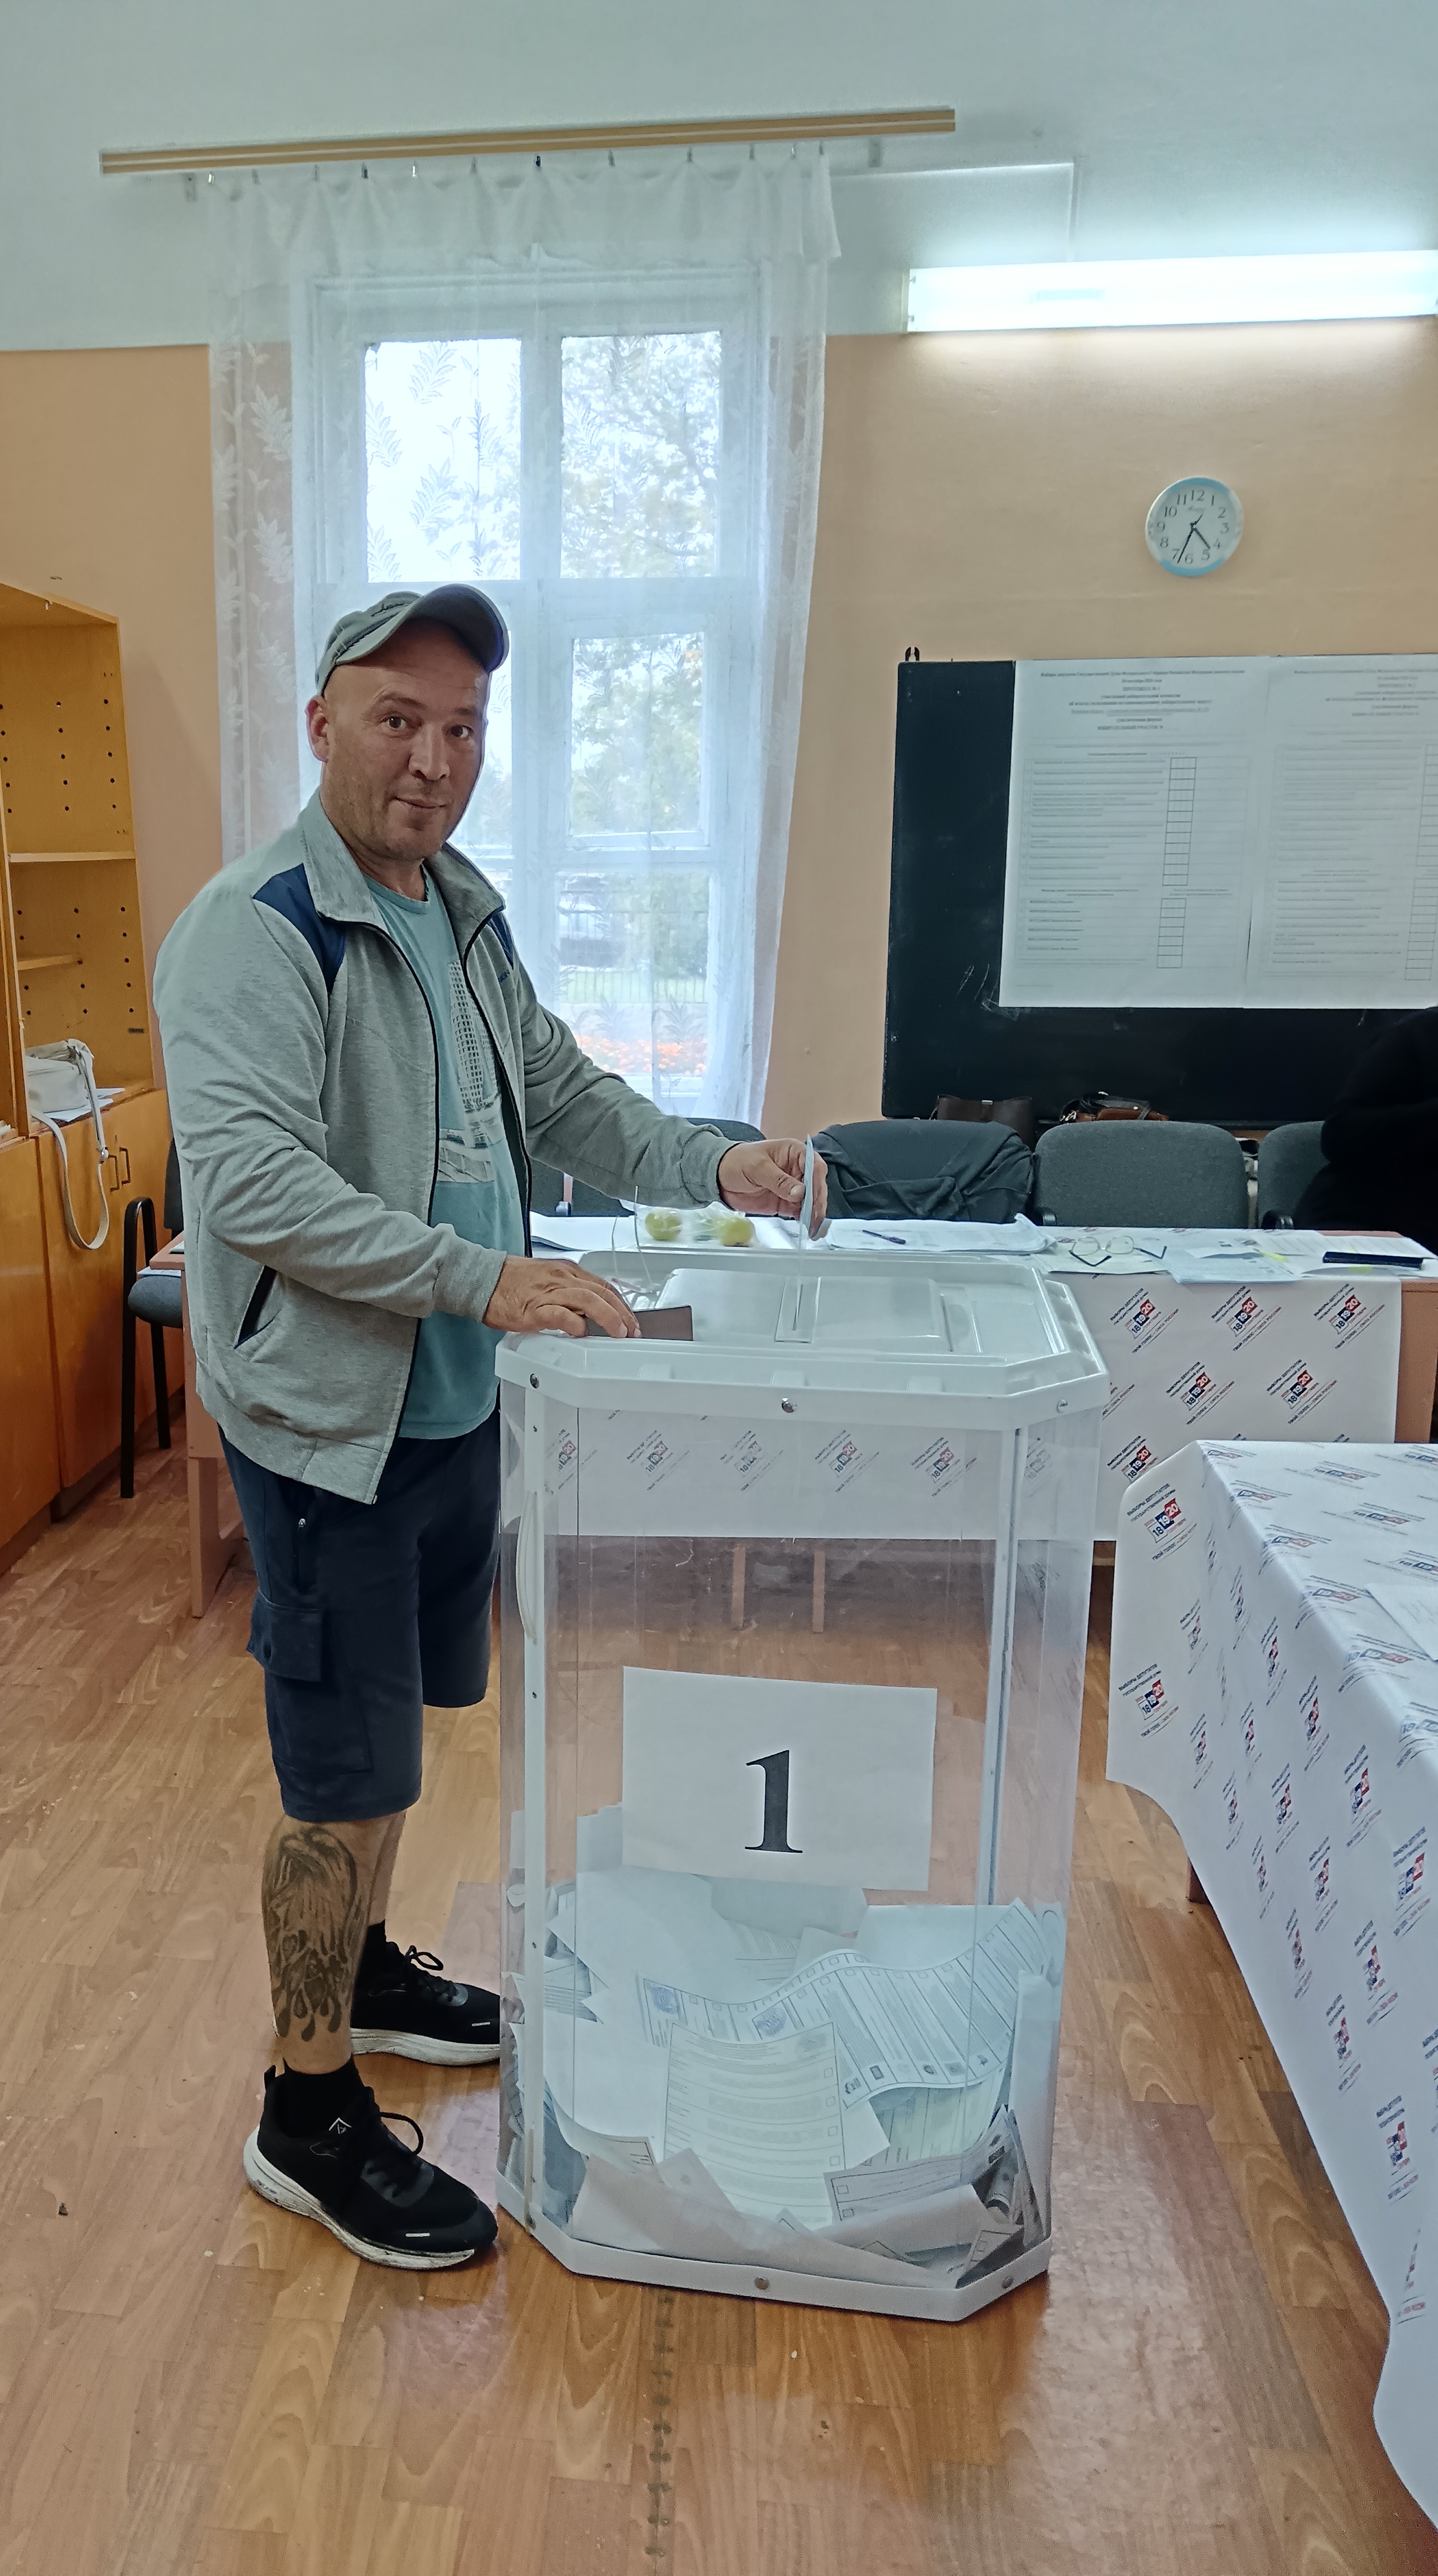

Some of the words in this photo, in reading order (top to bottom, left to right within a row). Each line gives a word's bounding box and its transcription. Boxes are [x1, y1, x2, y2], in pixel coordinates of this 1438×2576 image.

[1177, 494, 1187, 505] 11
[1191, 490, 1204, 501] 12
[1211, 495, 1214, 506] 1
[1164, 507, 1177, 517] 10
[1217, 507, 1225, 519] 2
[1157, 522, 1165, 532] 9
[1220, 523, 1229, 533] 3
[1160, 537, 1168, 548] 8
[1213, 539, 1221, 549] 4
[1172, 549, 1179, 559] 7
[1185, 553, 1193, 564] 6
[1201, 549, 1210, 560] 5
[1140, 1302, 1153, 1315] 20
[1242, 1300, 1255, 1312] 20
[1345, 1297, 1358, 1310] 20
[1135, 1313, 1146, 1324] 19
[1237, 1311, 1249, 1322] 19
[1340, 1308, 1351, 1320] 19
[1131, 1324, 1141, 1334] 18
[1233, 1321, 1243, 1332] 18
[1335, 1320, 1345, 1330] 18
[1196, 1375, 1208, 1387] 20
[1298, 1373, 1311, 1385] 20
[834, 1464, 844, 1473] 18
[843, 1443, 855, 1455] 20
[931, 1469, 940, 1479] 18
[1127, 1501, 1146, 1516] ВЫБОРЫ
[1164, 1502, 1180, 1517] 20
[1157, 1513, 1172, 1527] 19
[1152, 1525, 1164, 1538] 18
[745, 1750, 802, 1853] 1
